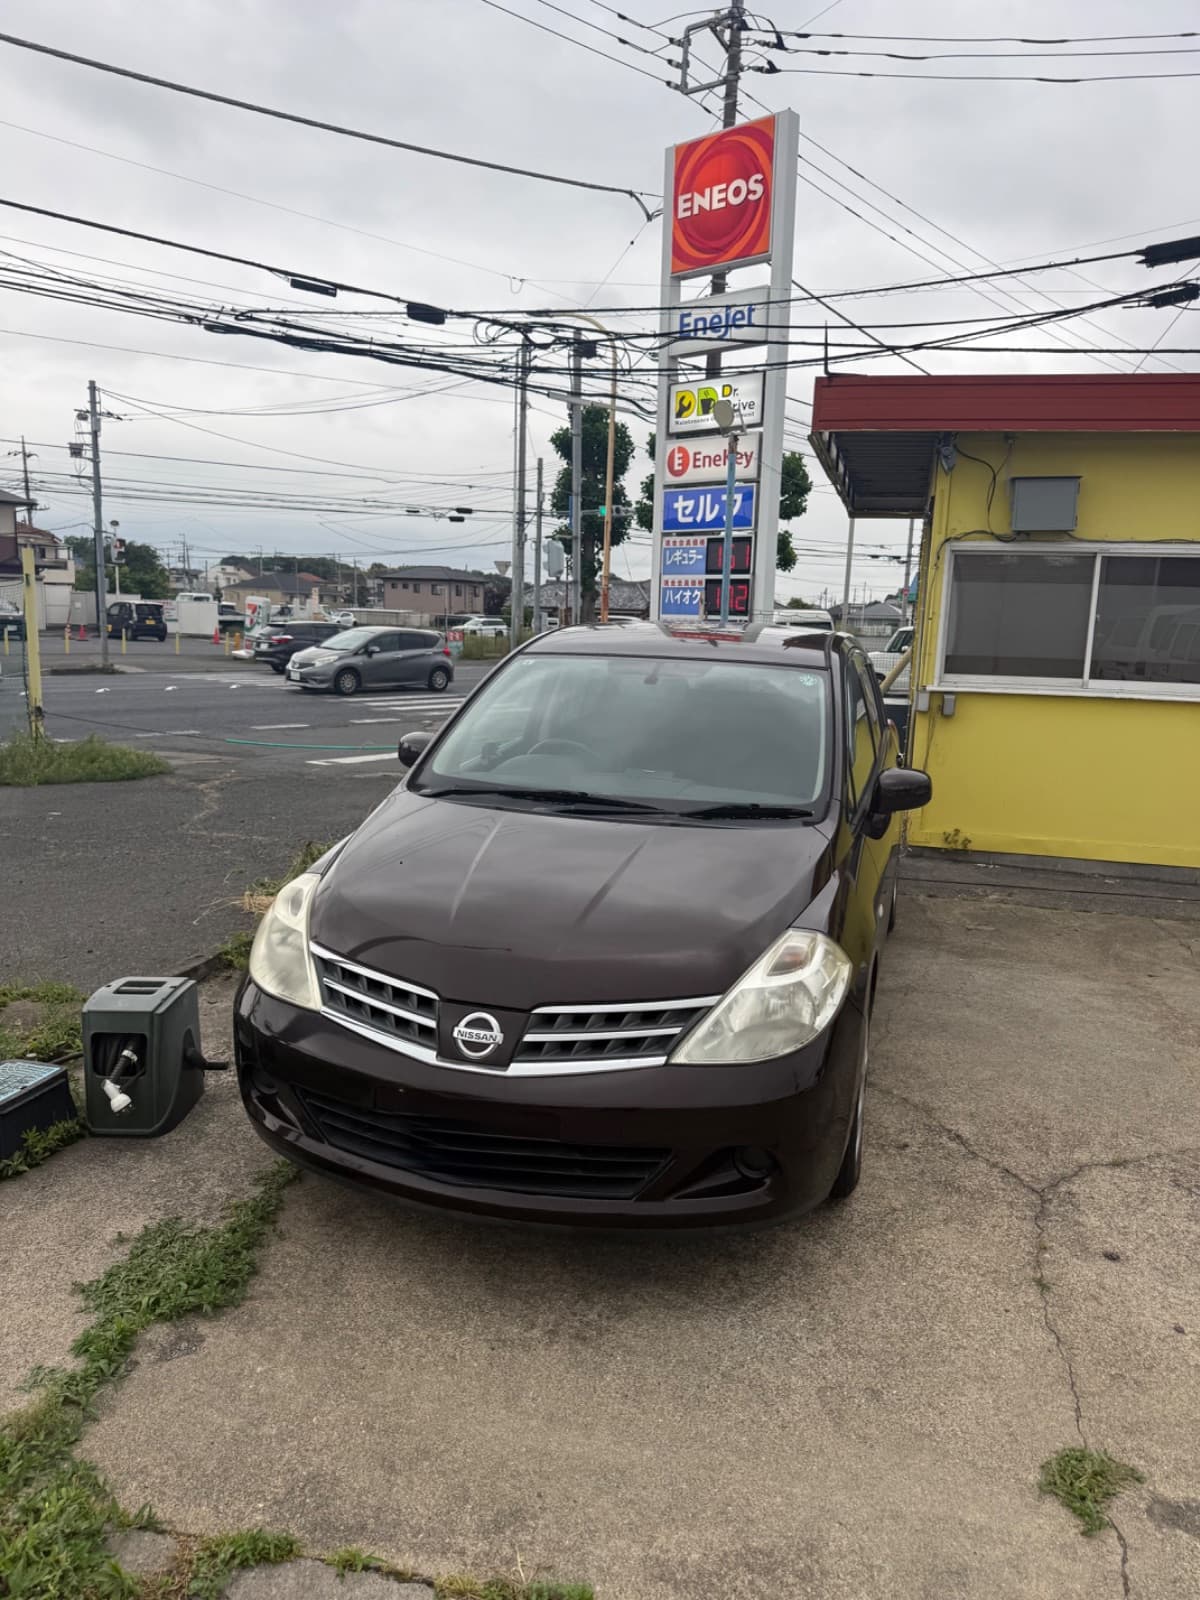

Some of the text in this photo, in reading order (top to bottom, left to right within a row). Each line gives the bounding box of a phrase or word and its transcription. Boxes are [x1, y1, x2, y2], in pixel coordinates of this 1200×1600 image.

[677, 173, 765, 220] ENEOS
[722, 383, 739, 398] Dr.
[727, 399, 756, 412] rive
[665, 549, 704, 566] レギュラー
[664, 589, 701, 605] ハイオク
[456, 1029, 498, 1042] NISSAN
